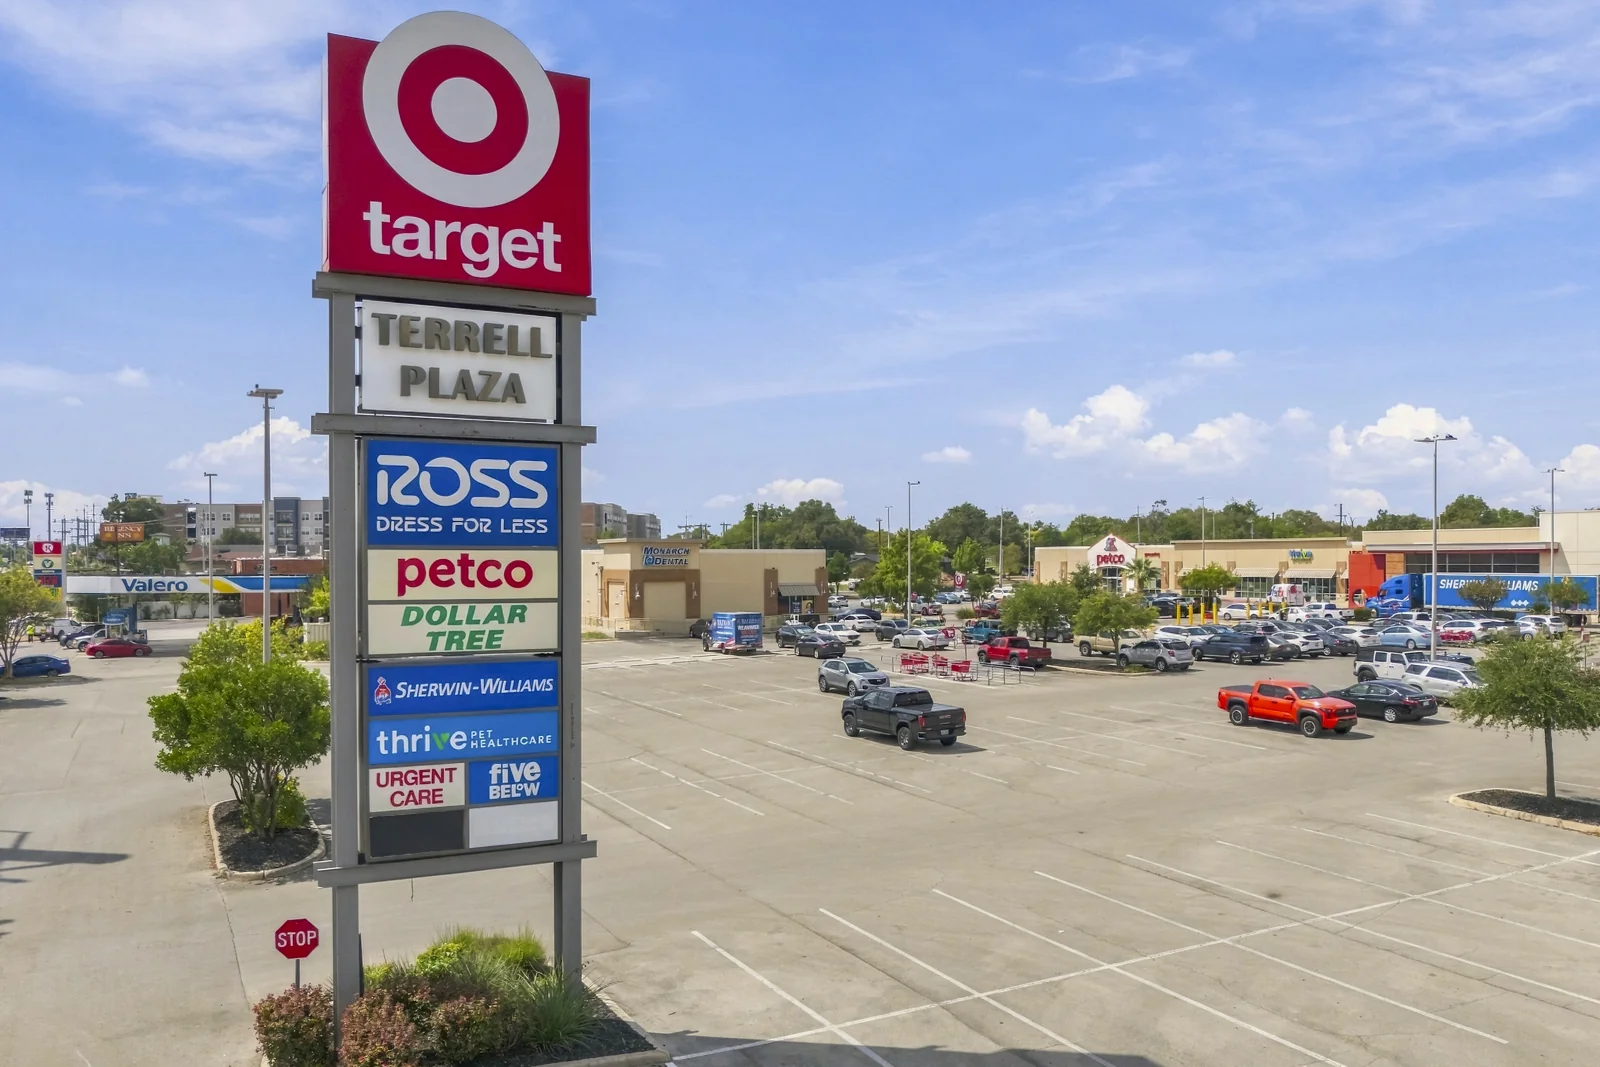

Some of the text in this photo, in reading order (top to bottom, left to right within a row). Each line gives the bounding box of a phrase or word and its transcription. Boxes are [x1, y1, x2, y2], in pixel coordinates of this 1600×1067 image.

[363, 201, 562, 278] target
[371, 312, 553, 359] TERRELL
[400, 365, 527, 404] PLAZA
[377, 454, 548, 509] ROSS
[376, 516, 548, 534] DRESS FOR LESS
[643, 546, 690, 555] MONARCH
[655, 557, 689, 565] DENTAL
[1096, 553, 1125, 566] petco
[121, 578, 188, 592] Valero
[397, 553, 533, 597] petco
[400, 604, 528, 627] DOLLAR
[426, 629, 504, 651] TREE
[395, 677, 554, 699] SHERWIN-WILLIAMS
[376, 725, 468, 755] thrive
[470, 735, 552, 749] HEALTHCARE
[471, 729, 493, 739] PET
[376, 767, 457, 788] URGENT
[489, 761, 541, 784] five
[390, 788, 444, 808] CARE
[277, 930, 317, 948] STOP
